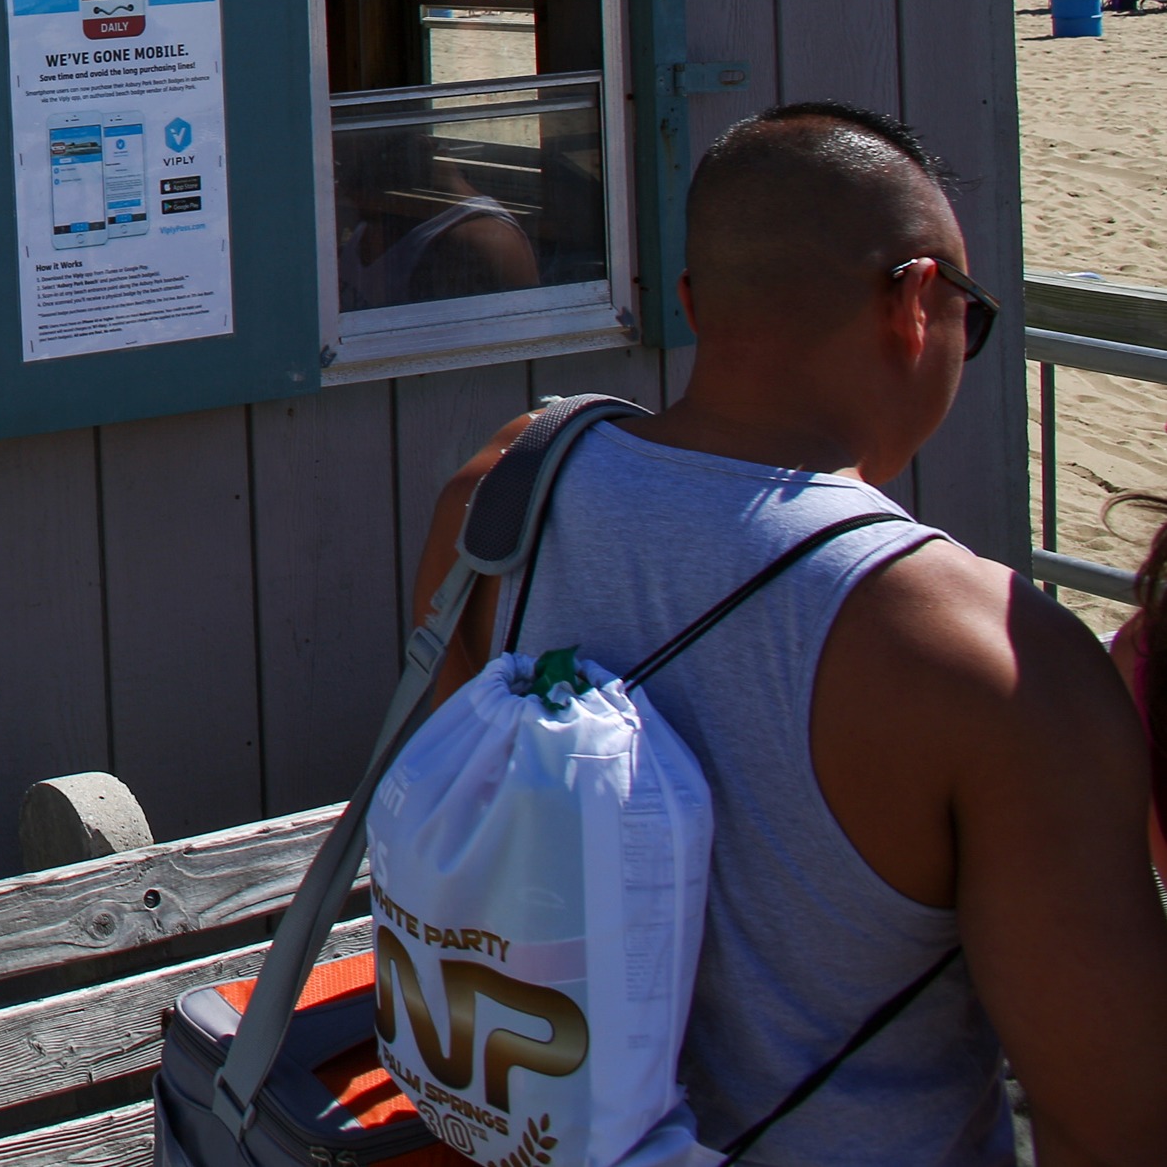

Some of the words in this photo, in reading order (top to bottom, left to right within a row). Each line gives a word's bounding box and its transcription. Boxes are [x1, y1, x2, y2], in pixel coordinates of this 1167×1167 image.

[100, 21, 129, 33] DAILY
[93, 48, 131, 64] GONE
[134, 44, 189, 61] MOBILE.
[39, 74, 56, 82] Save
[57, 72, 74, 81] time
[75, 70, 89, 79] and
[90, 69, 109, 77] avoid
[110, 68, 121, 76] the
[123, 67, 138, 76] long
[139, 63, 177, 75] purchasing
[91, 84, 112, 92] purchase
[163, 155, 195, 167] VIPLY
[185, 182, 198, 190] Store
[174, 203, 189, 211] Google
[190, 201, 199, 209] Play
[36, 264, 52, 272] How
[53, 262, 59, 270] it
[60, 260, 83, 269] Works
[424, 922, 511, 963] PARTY
[383, 1044, 422, 1095] PALM
[424, 1081, 509, 1137] SPRINGS
